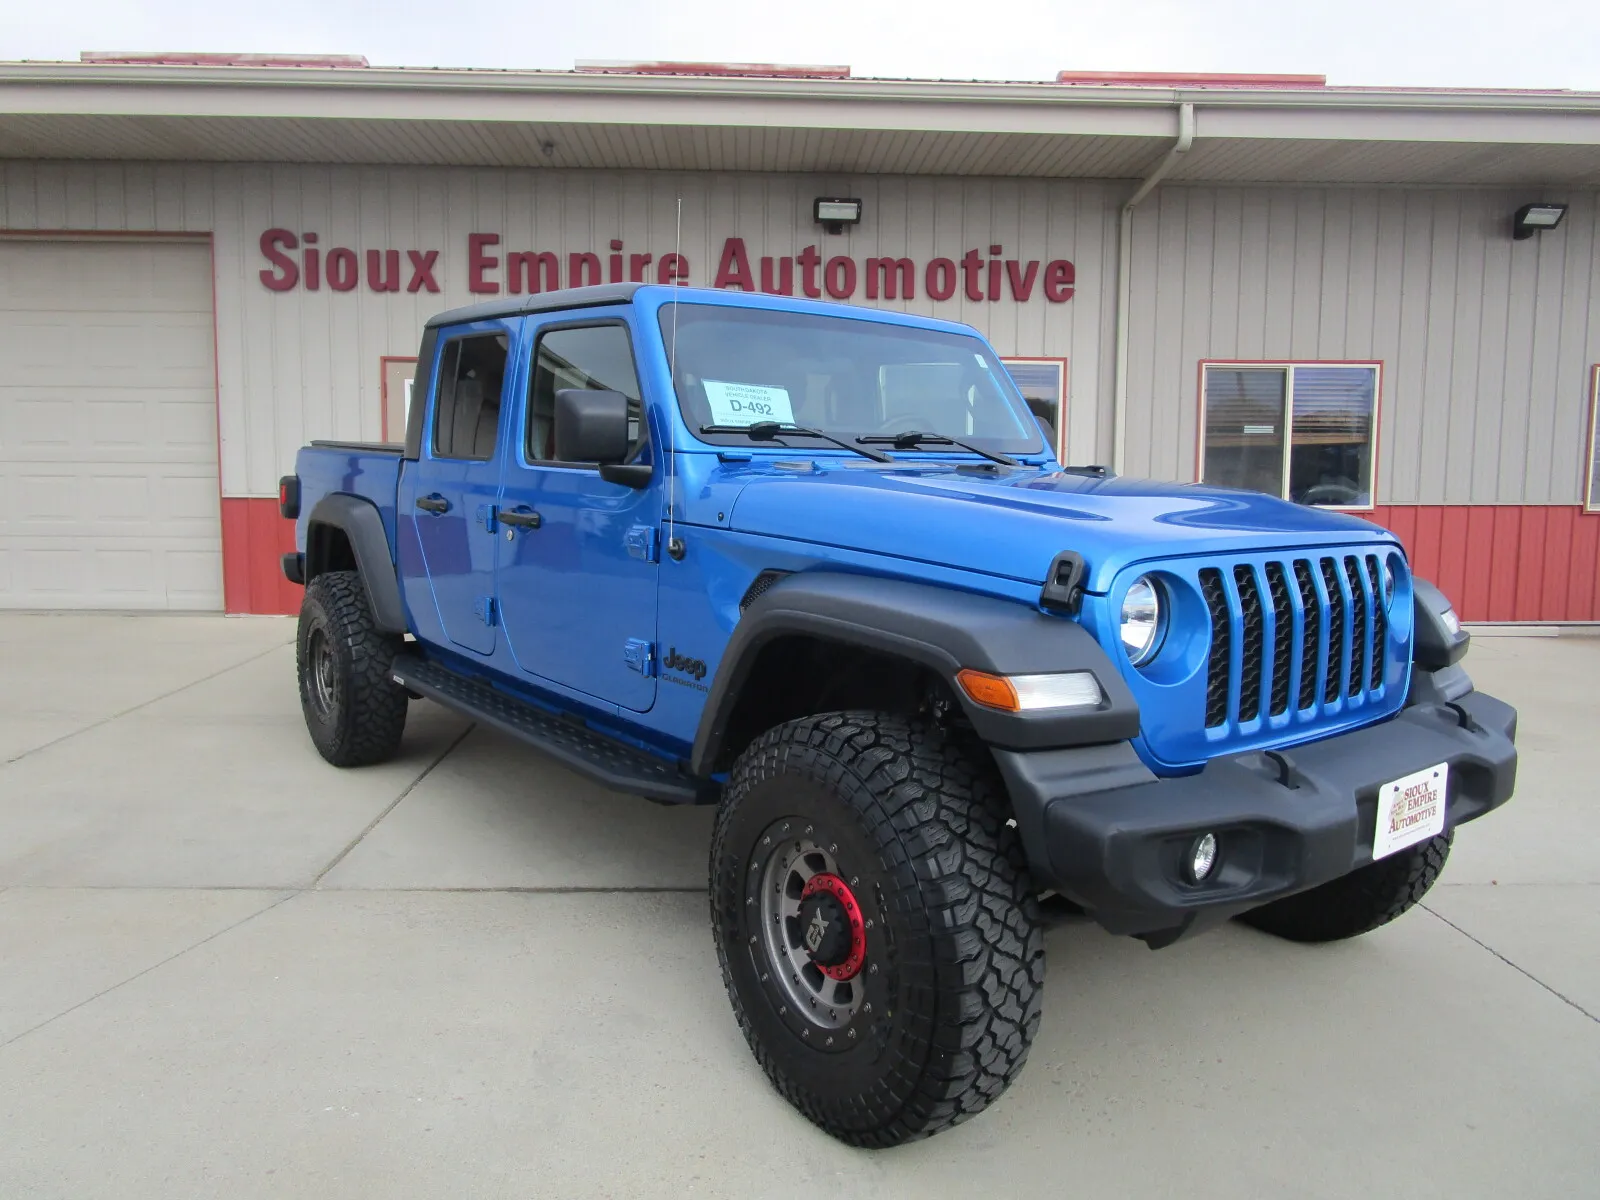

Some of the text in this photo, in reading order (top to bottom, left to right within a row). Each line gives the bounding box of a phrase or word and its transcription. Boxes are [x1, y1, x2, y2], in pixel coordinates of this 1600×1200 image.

[259, 228, 440, 293] Sioux
[714, 237, 1076, 302] Automotive
[730, 399, 774, 416] D-492
[663, 647, 706, 681] Jeep
[662, 673, 709, 693] GLADIATOR
[1404, 780, 1430, 801] SIOUX
[1407, 789, 1438, 811] EMPIRE
[1388, 805, 1437, 834] AUTOMOTIVE
